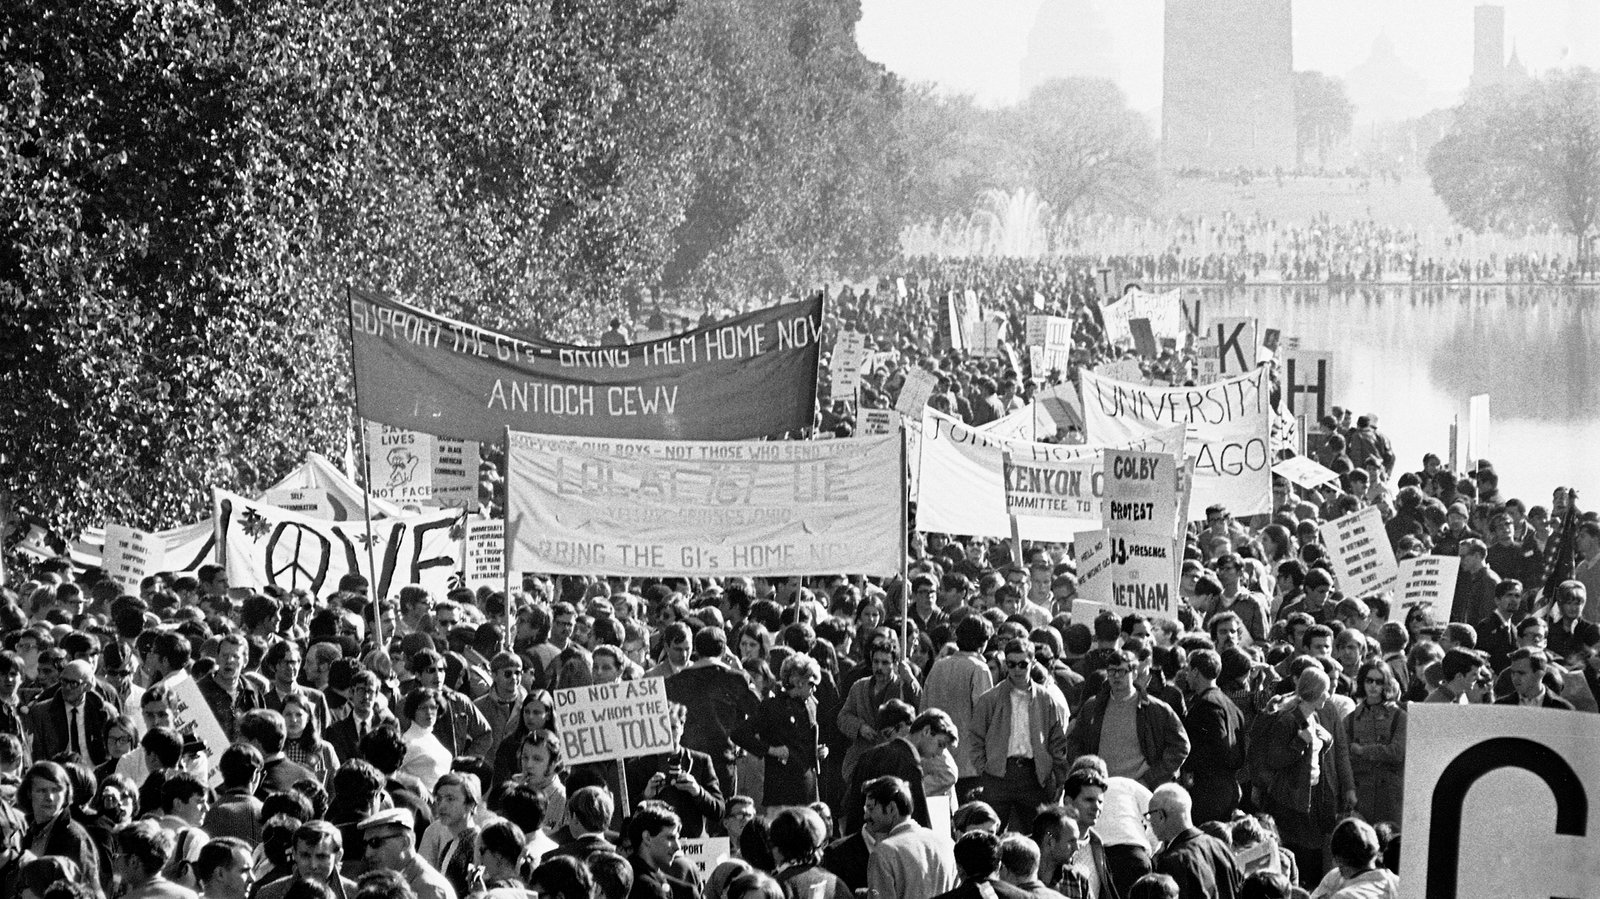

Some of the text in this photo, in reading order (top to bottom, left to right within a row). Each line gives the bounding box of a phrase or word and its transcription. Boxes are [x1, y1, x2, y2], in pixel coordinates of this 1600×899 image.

[351, 299, 442, 348] SUPPORT
[449, 324, 489, 358] THE
[559, 348, 630, 369] BRING
[644, 335, 696, 367] THEM
[705, 323, 766, 362] HOME
[1217, 322, 1248, 374] K
[488, 379, 678, 416] ANTIOCH CEWV
[1095, 371, 1263, 424] UNIVERSITY
[1287, 358, 1326, 422] H
[381, 423, 406, 433] SA
[381, 434, 415, 446] LIVES
[582, 441, 610, 455] OUR
[616, 443, 650, 456] BOYS
[665, 445, 693, 459] NOT
[699, 446, 743, 459] THOSE
[749, 445, 779, 459] WHO
[785, 445, 820, 459] SEND
[1114, 455, 1160, 480] COLBY
[1003, 463, 1082, 498] KENYON
[372, 486, 432, 498] NOT FACE
[277, 503, 318, 511] TERMINATION
[1006, 495, 1068, 511] OMMITTEE
[1077, 501, 1091, 512] TO
[1111, 500, 1154, 521] PROTEST
[119, 540, 129, 548] THE
[1129, 545, 1166, 558] PRESENCE
[122, 552, 146, 565] SUPPORT
[539, 541, 606, 566] BRING
[617, 545, 665, 568] THE
[681, 546, 718, 568] GI's
[732, 544, 794, 568] HOME
[1102, 558, 1110, 568] GO
[1415, 559, 1440, 567] SUPPORT
[556, 679, 658, 707] DO NOT ASK
[560, 701, 664, 727] FOR WHOM THE
[562, 715, 671, 759] BELL TOLLS
[681, 844, 704, 855] PORT
